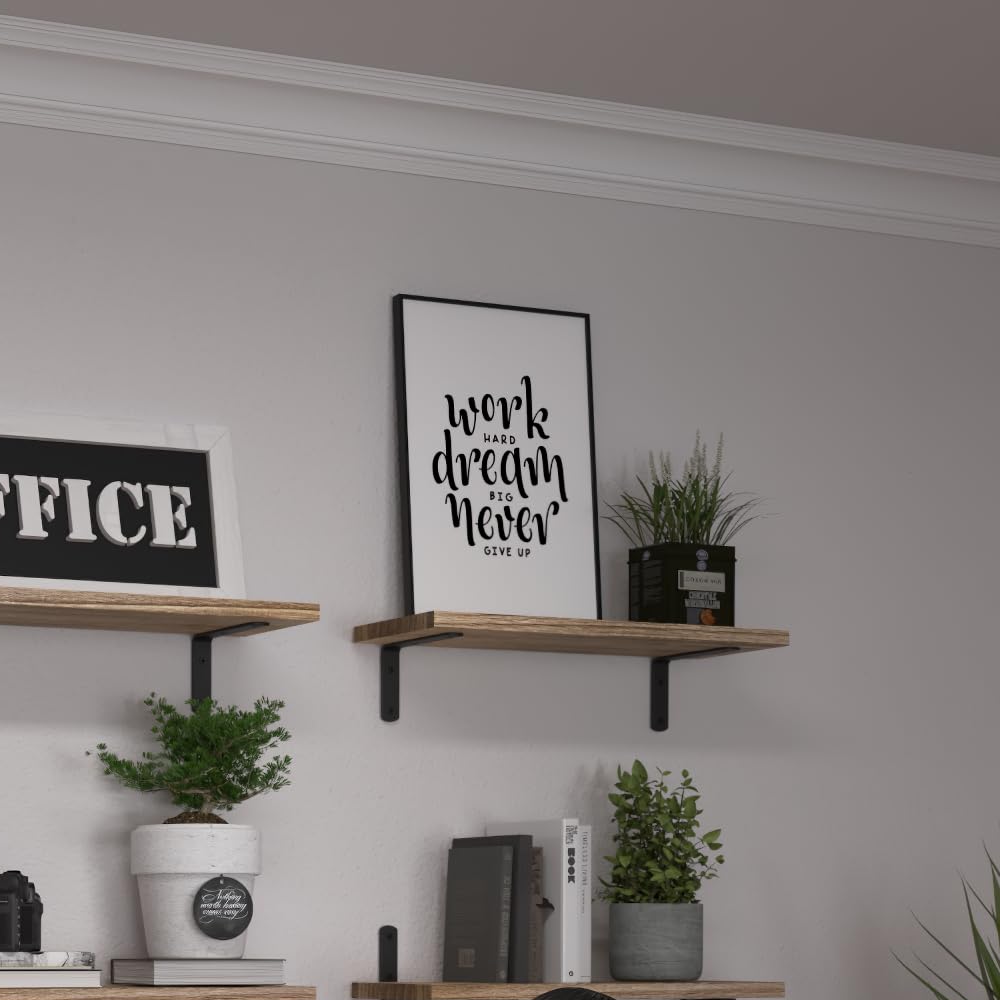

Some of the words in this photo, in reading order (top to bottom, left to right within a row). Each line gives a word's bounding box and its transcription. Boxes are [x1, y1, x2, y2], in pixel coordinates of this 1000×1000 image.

[444, 375, 550, 440] work
[483, 432, 516, 445] HARD
[432, 428, 569, 503] dream
[489, 491, 514, 502] BIG
[484, 546, 512, 557] GIVE
[517, 548, 531, 558] UP
